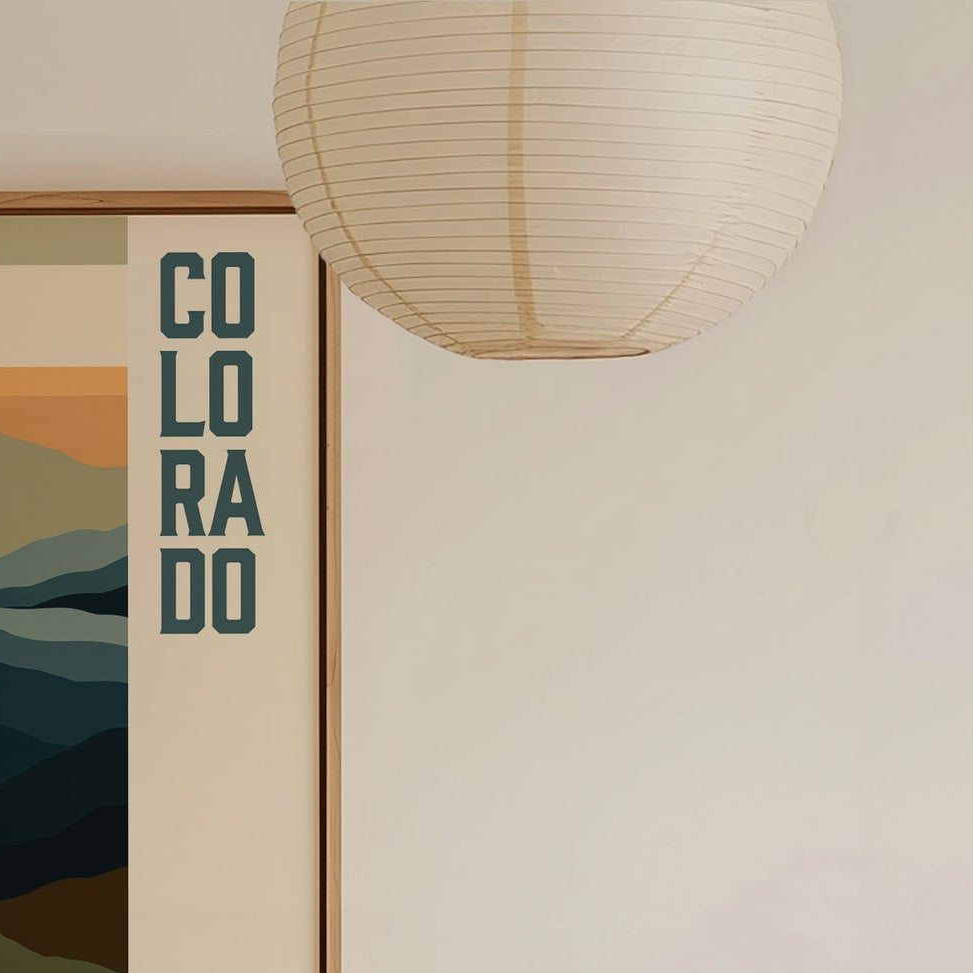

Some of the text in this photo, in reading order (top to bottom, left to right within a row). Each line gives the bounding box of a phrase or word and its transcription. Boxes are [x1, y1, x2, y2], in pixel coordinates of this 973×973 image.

[160, 252, 255, 339] CO
[160, 350, 253, 437] LO
[160, 449, 265, 536] RA
[160, 548, 256, 634] DO
